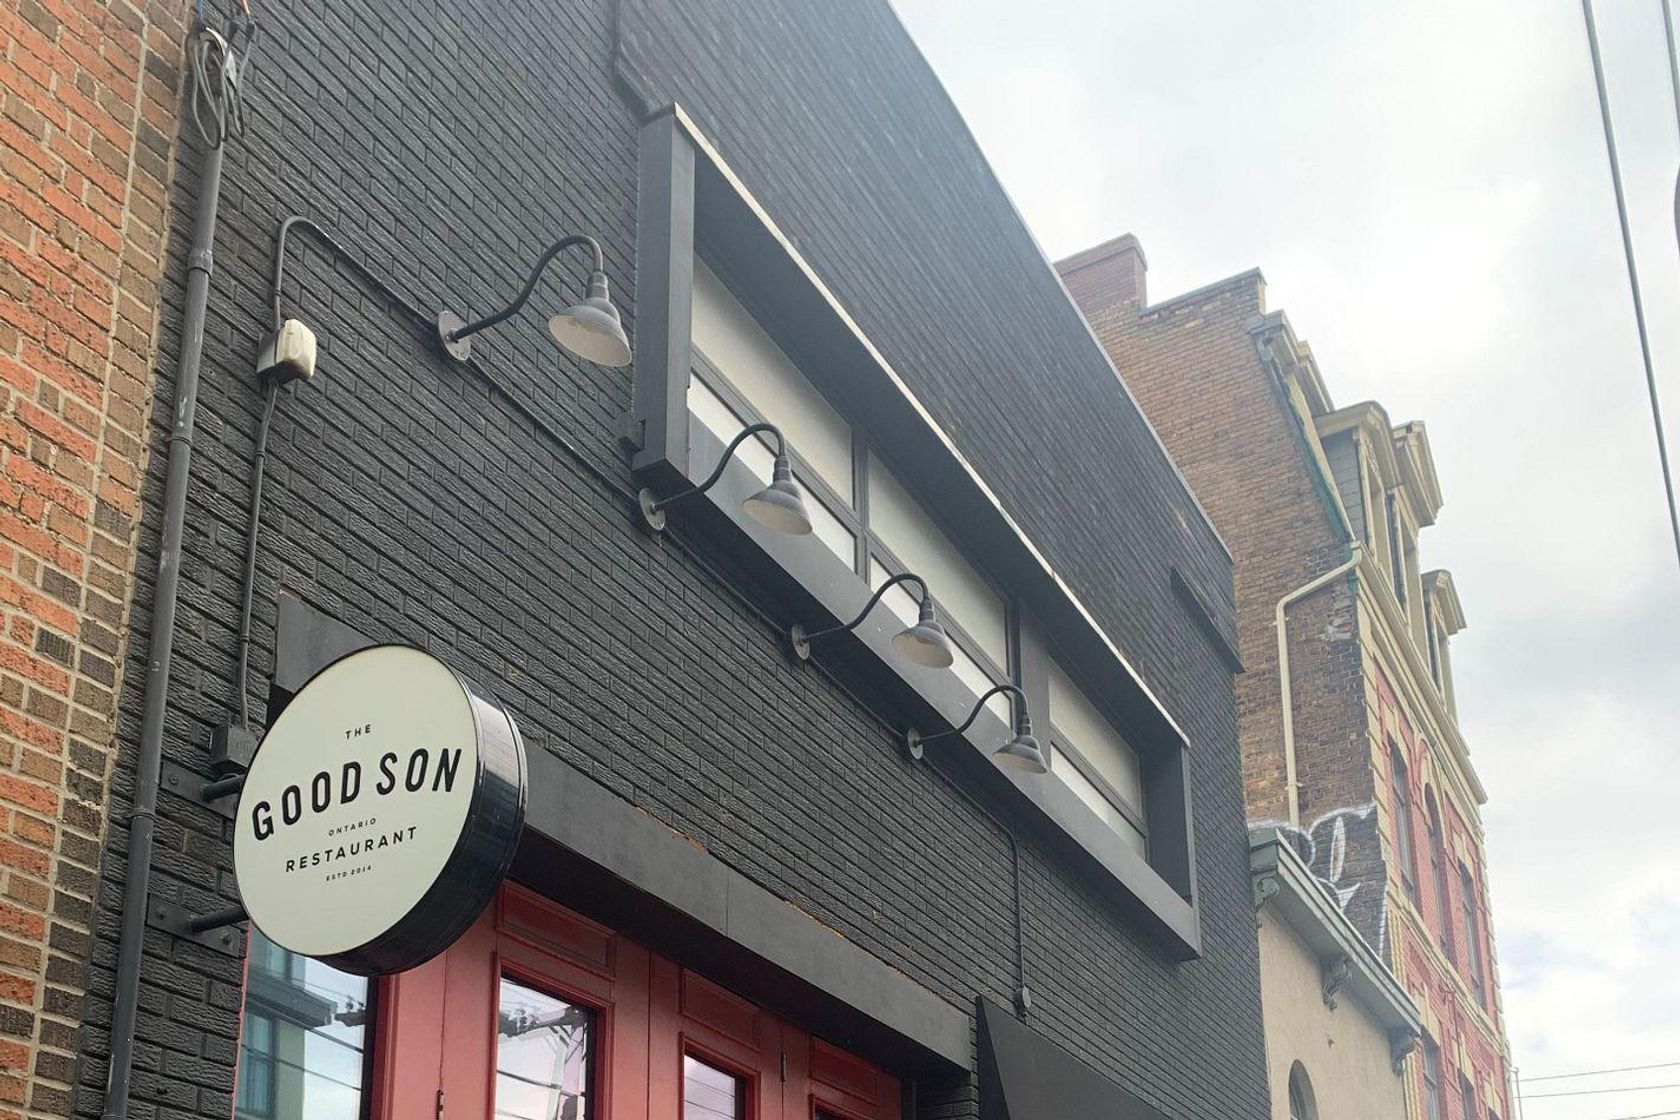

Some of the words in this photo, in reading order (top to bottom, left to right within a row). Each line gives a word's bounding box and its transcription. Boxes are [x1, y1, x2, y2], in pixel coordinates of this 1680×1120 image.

[345, 724, 372, 740] THE
[252, 761, 362, 841] GOOD
[375, 748, 463, 796] SON
[328, 817, 377, 837] ONTARIO
[285, 826, 418, 873] RESTAURANT
[326, 870, 349, 882] ESTD
[350, 864, 373, 876] 2014
